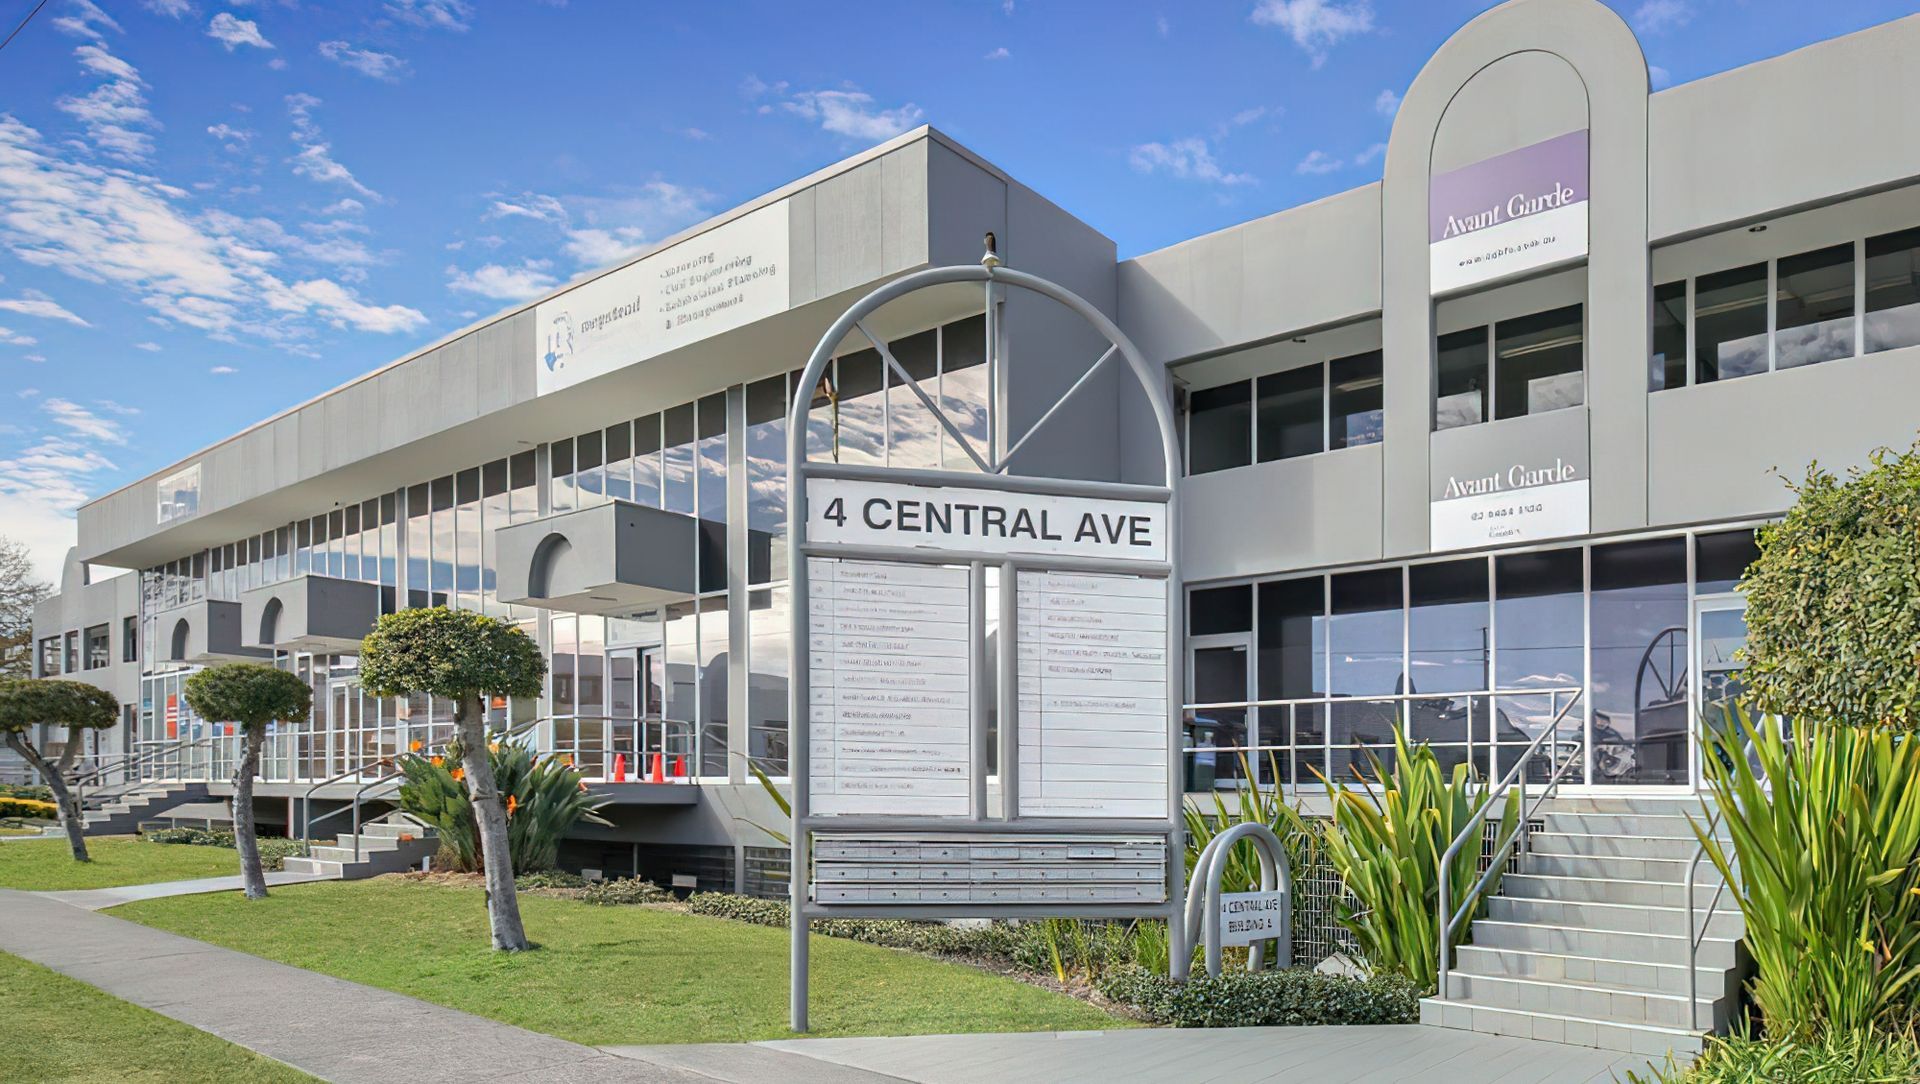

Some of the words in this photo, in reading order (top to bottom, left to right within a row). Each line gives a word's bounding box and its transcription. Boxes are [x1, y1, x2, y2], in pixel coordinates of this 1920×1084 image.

[1443, 205, 1500, 239] Avant
[1506, 182, 1574, 218] Garde
[1443, 472, 1500, 499] Avant
[1508, 458, 1576, 488] Garde
[823, 497, 847, 528] 4
[862, 497, 1062, 541] CENTRAL
[1074, 512, 1152, 547] AVE
